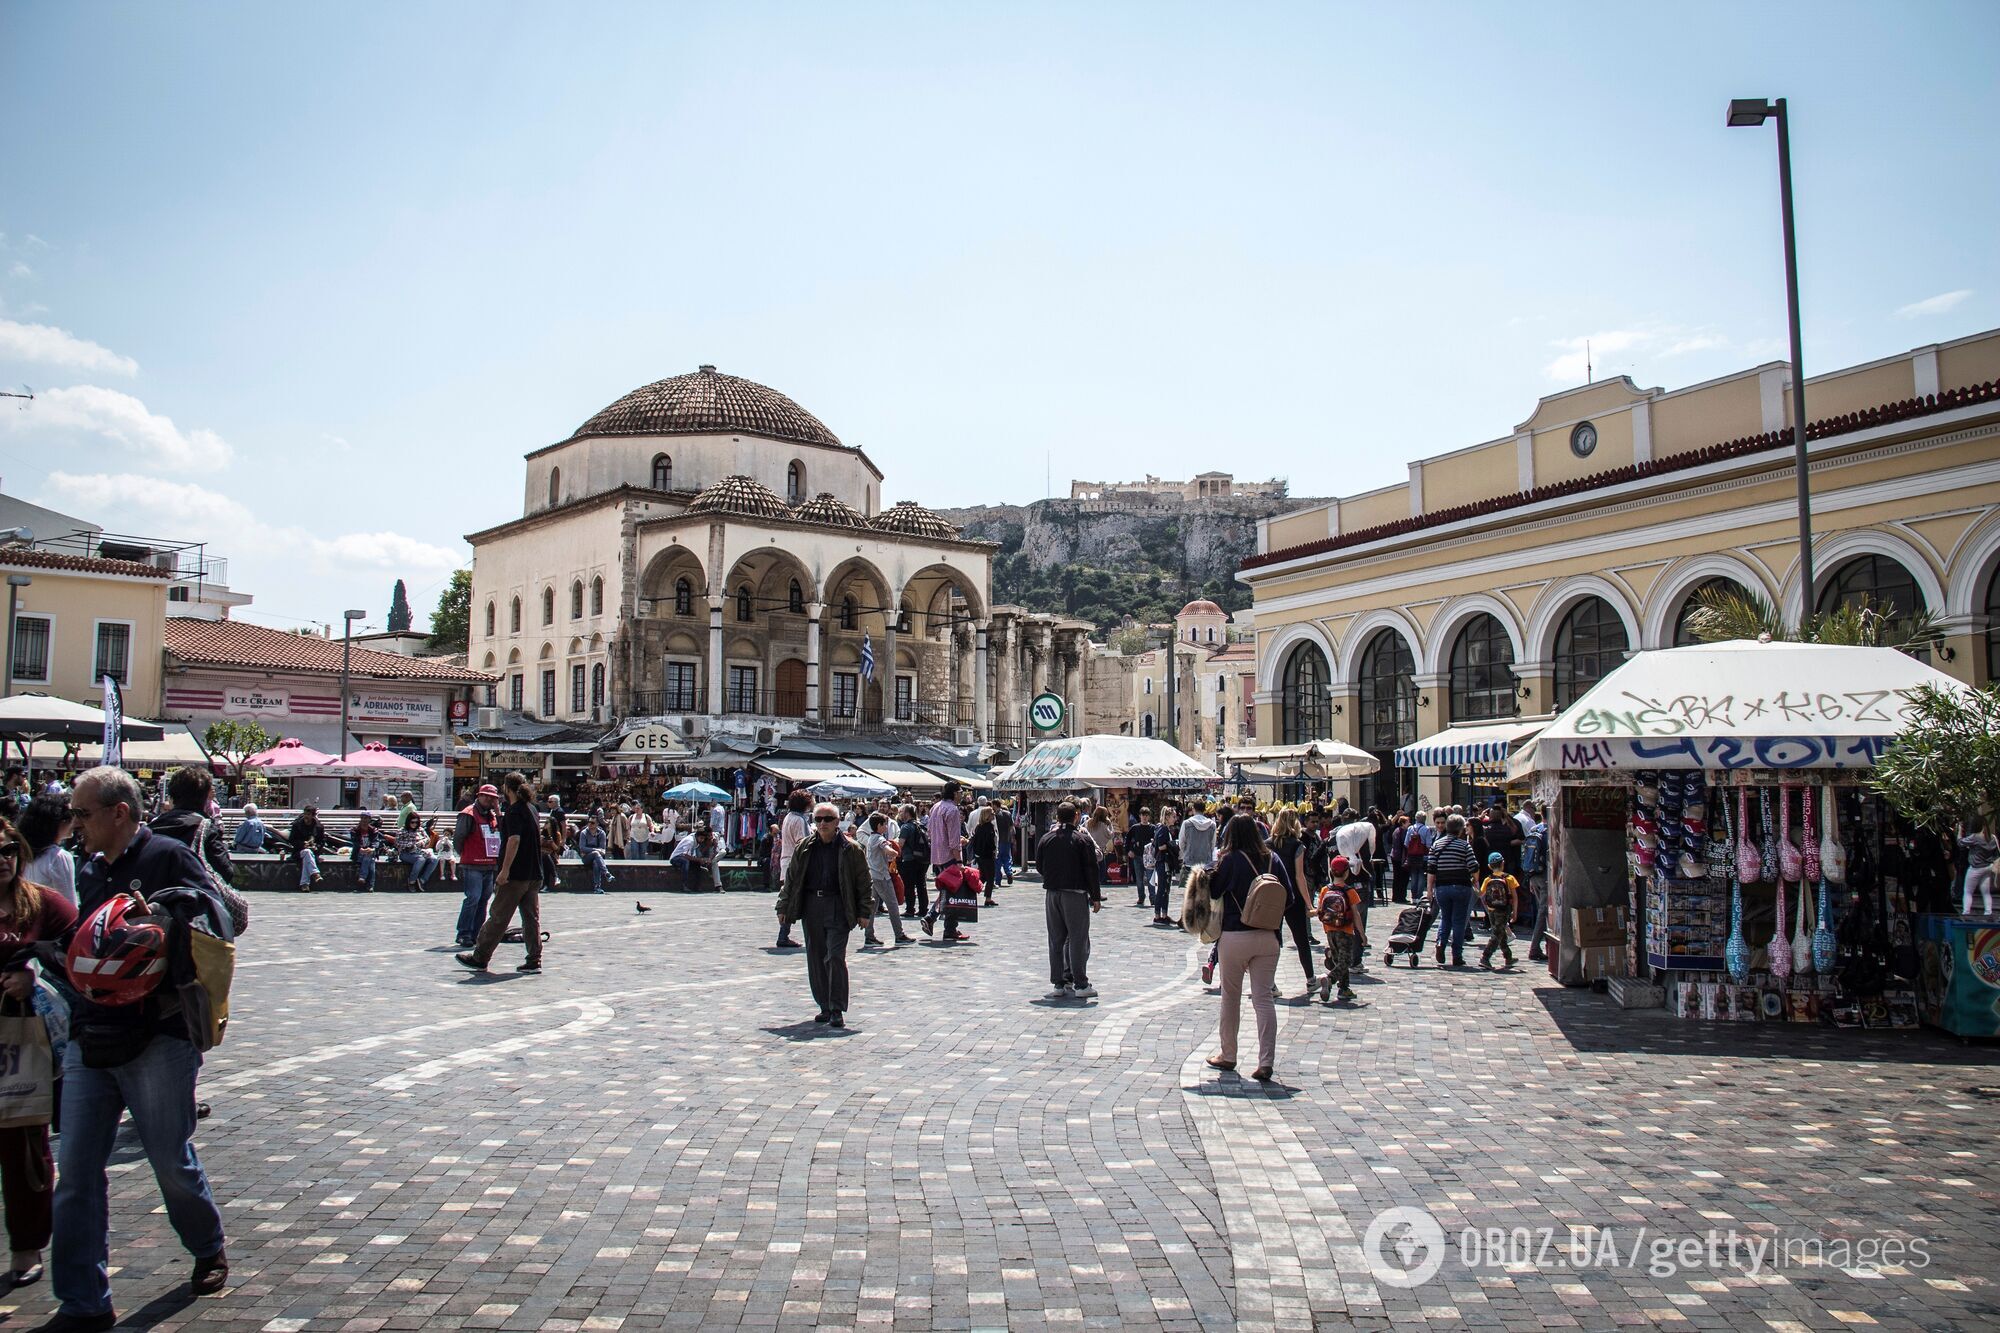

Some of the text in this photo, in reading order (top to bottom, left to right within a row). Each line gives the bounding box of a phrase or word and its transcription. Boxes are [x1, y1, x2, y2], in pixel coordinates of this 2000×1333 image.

[231, 696, 283, 705] ICE CREAM
[364, 701, 433, 712] ADRIANOS TRAVEL
[635, 734, 669, 749] GES
